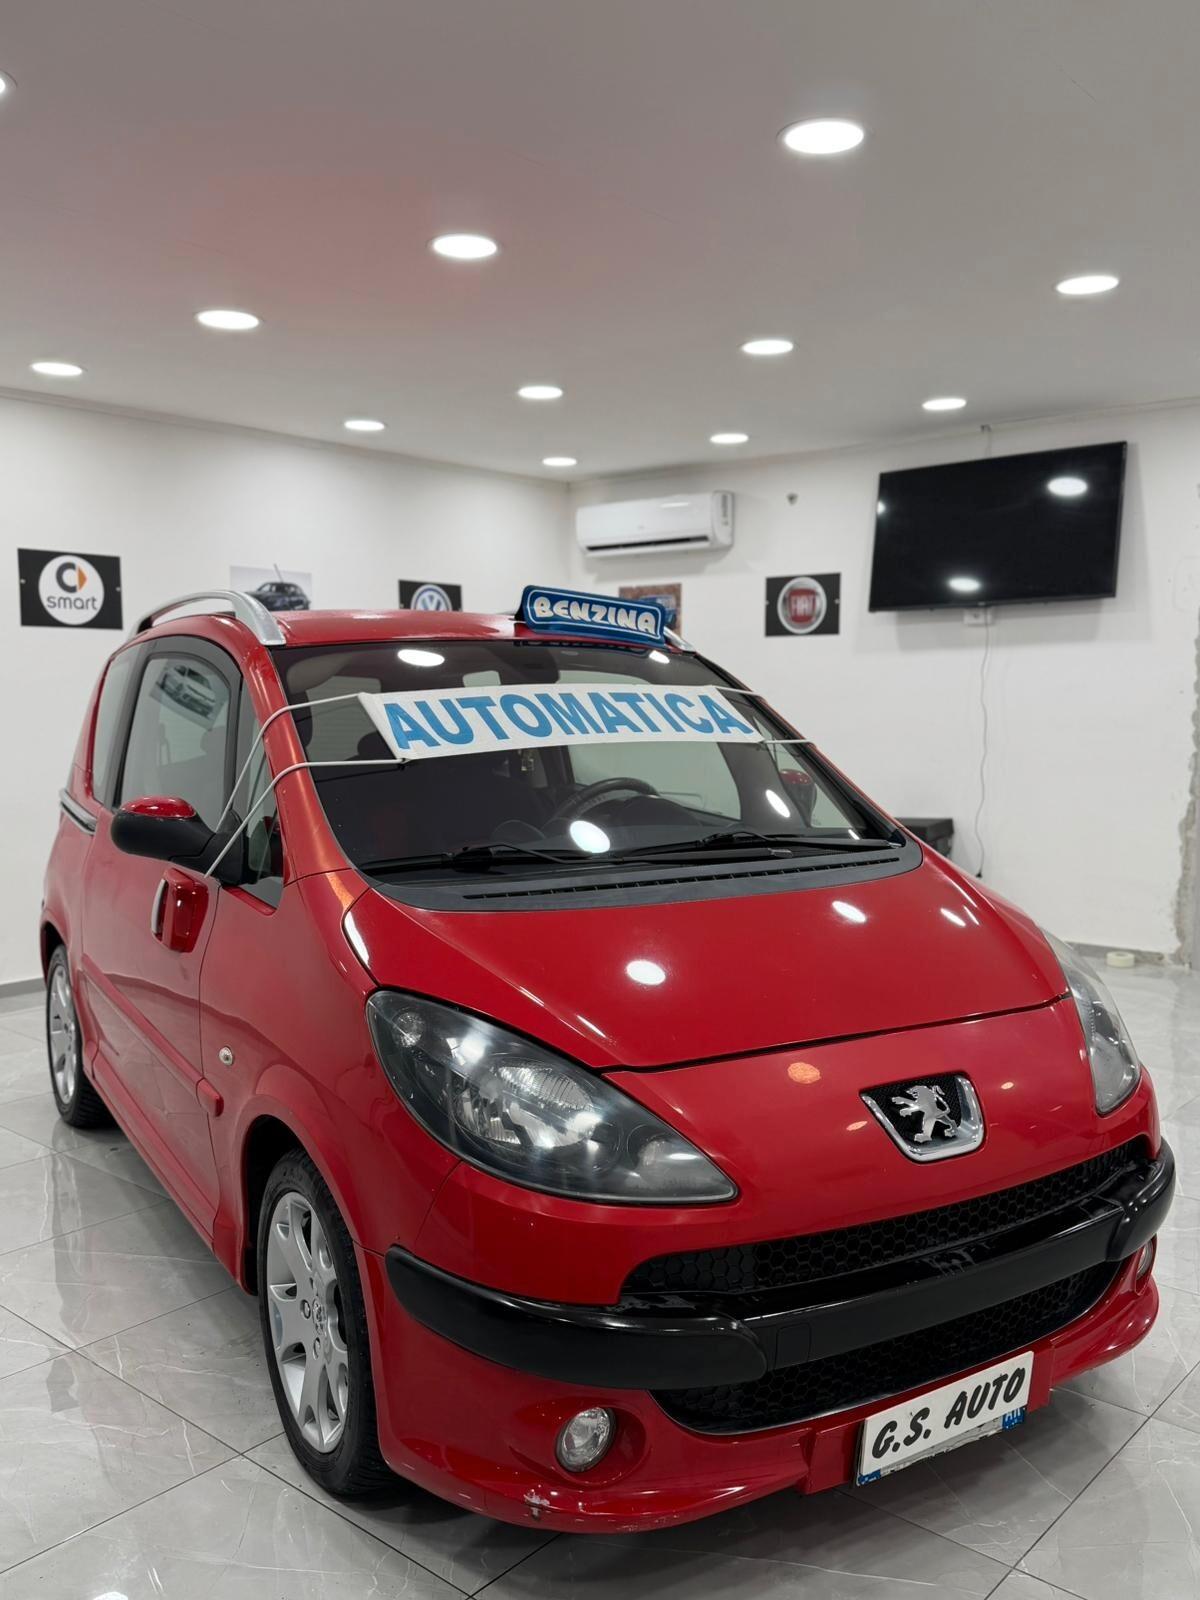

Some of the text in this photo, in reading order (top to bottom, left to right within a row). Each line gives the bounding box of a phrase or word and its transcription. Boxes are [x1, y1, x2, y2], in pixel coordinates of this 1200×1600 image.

[46, 596, 97, 610] smart
[533, 597, 656, 634] BENZINA
[384, 692, 753, 750] AUTOMATICA
[872, 1368, 1026, 1459] G.S. AUTO
